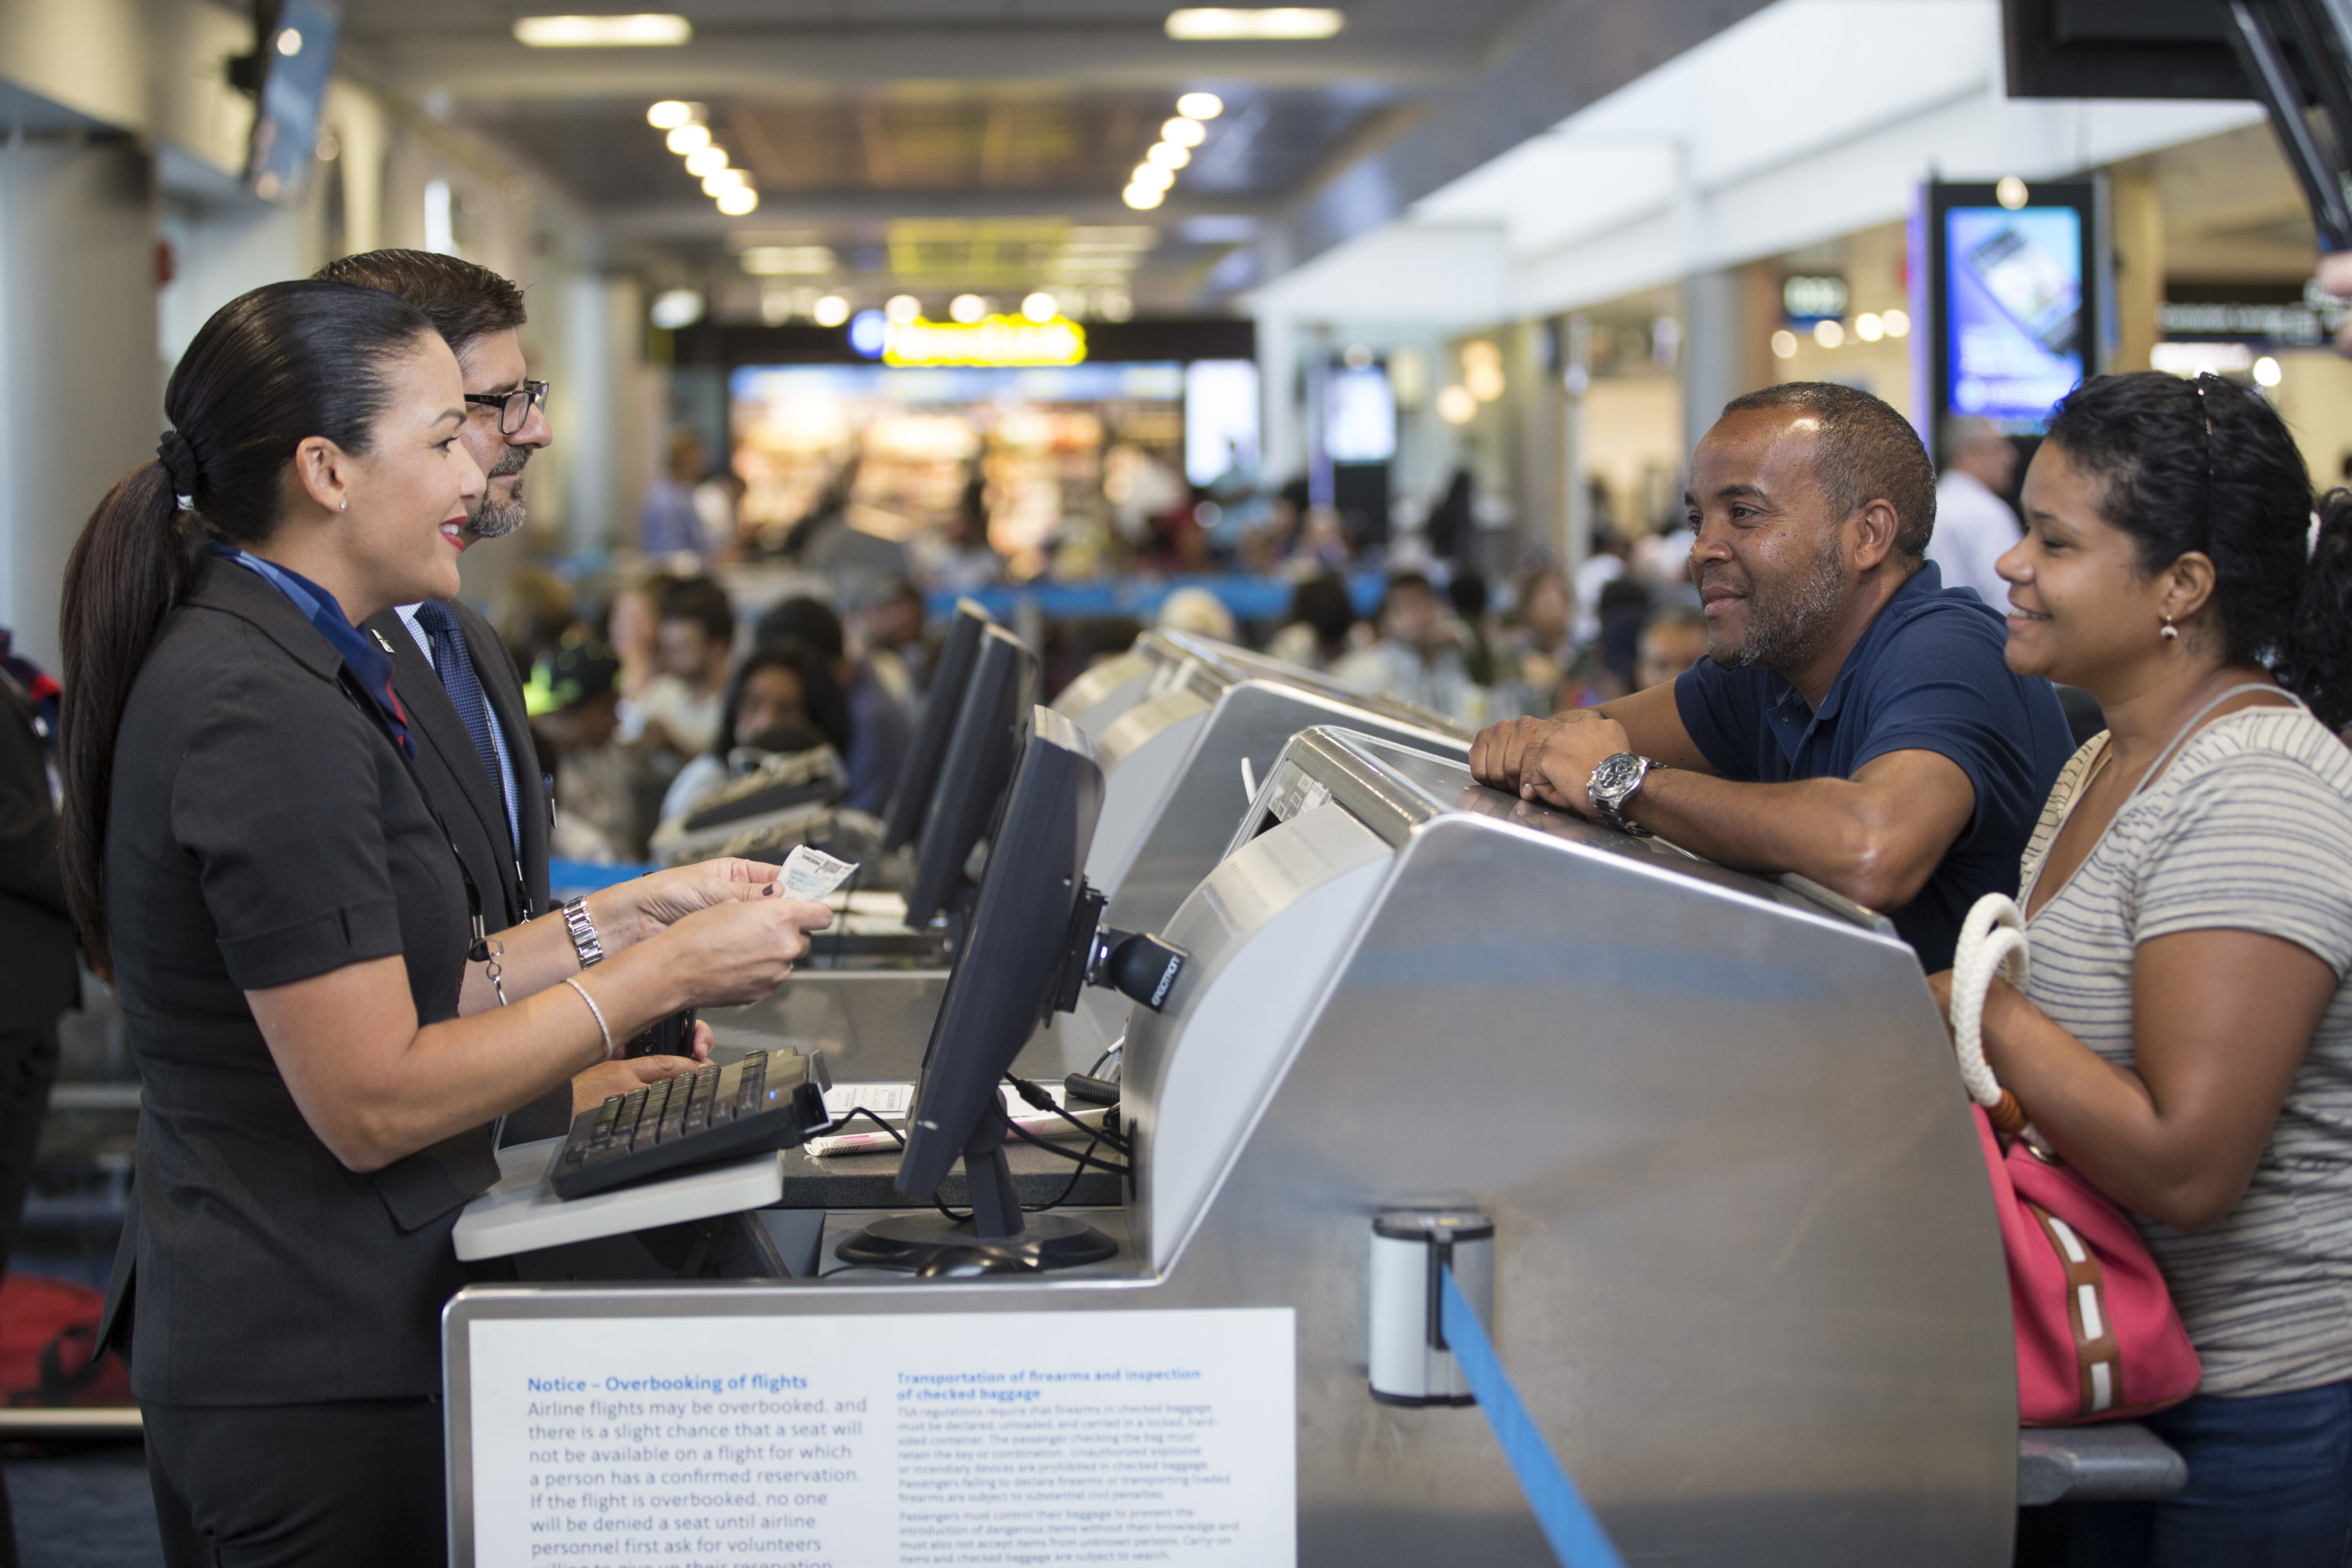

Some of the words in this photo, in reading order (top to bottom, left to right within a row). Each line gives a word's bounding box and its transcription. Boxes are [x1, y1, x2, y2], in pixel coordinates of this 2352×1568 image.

[528, 1378, 586, 1392] Notice
[605, 1377, 722, 1394] Overbooking
[728, 1375, 746, 1389] of
[751, 1374, 807, 1393] flights
[898, 1373, 1005, 1386] Transportation
[1010, 1370, 1025, 1382] of
[1029, 1370, 1090, 1381] firearms
[1094, 1370, 1121, 1381] and
[1125, 1370, 1200, 1383] inspection
[897, 1388, 913, 1400] of
[916, 1388, 975, 1399] checked
[980, 1388, 1041, 1402] baggage
[528, 1402, 585, 1416] Airline
[590, 1400, 644, 1421] flights
[649, 1403, 686, 1419] may
[691, 1400, 713, 1415] be
[834, 1399, 866, 1413] and
[898, 1406, 918, 1417] TSA
[920, 1407, 984, 1421] regulations
[985, 1406, 1028, 1418] require
[1029, 1405, 1053, 1415] that
[1054, 1404, 1102, 1414] firearms
[1116, 1403, 1163, 1414] checked
[1165, 1403, 1212, 1417] baggage
[528, 1425, 575, 1440] there
[582, 1425, 593, 1439] is
[599, 1428, 610, 1439] a
[615, 1424, 661, 1443] slight
[666, 1425, 729, 1438] chance
[735, 1423, 770, 1437] that
[775, 1425, 786, 1436] a
[791, 1424, 826, 1436] seat
[832, 1421, 862, 1436] will
[897, 1422, 926, 1432] must
[927, 1421, 942, 1432] be
[1058, 1419, 1079, 1429] and
[1080, 1418, 1121, 1429] carried
[897, 1436, 927, 1446] sided
[989, 1433, 1010, 1444] The
[1011, 1435, 1069, 1447] passenger
[1070, 1433, 1120, 1446] checking
[1121, 1432, 1141, 1443] the
[1143, 1432, 1164, 1445] bag
[1166, 1432, 1195, 1442] must
[529, 1450, 558, 1463] not
[564, 1449, 586, 1463] be
[591, 1447, 670, 1462] available
[674, 1449, 697, 1461] on
[702, 1450, 713, 1461] a
[718, 1445, 763, 1465] flight
[769, 1444, 794, 1460] for
[799, 1445, 851, 1459] which
[897, 1450, 931, 1460] retain
[933, 1450, 953, 1460] the
[955, 1450, 975, 1461] key
[975, 1450, 989, 1460] or
[1071, 1446, 1148, 1457] Unauthorized
[1149, 1446, 1202, 1459] explosive
[897, 1466, 910, 1475] or
[913, 1464, 971, 1476] incendiary
[973, 1463, 1015, 1474] devices
[1017, 1464, 1036, 1473] are
[1038, 1461, 1097, 1475] prohibited
[1112, 1461, 1159, 1471] checked
[529, 1475, 539, 1486] a
[546, 1474, 604, 1490] person
[611, 1471, 641, 1485] has
[645, 1473, 655, 1484] a
[661, 1468, 750, 1484] confirmed
[898, 1479, 959, 1492] Passengers
[962, 1477, 996, 1490] failing
[998, 1478, 1011, 1488] to
[1013, 1477, 1054, 1487] declare
[1057, 1475, 1104, 1486] firearms
[1105, 1476, 1118, 1486] or
[1120, 1475, 1189, 1488] transporting
[1192, 1474, 1231, 1484] loaded
[531, 1494, 543, 1508] If
[547, 1495, 576, 1509] the
[582, 1493, 627, 1513] flight
[633, 1494, 645, 1508] is
[766, 1494, 789, 1506] no
[794, 1494, 827, 1505] one
[898, 1493, 945, 1503] firearms
[946, 1494, 966, 1502] are
[968, 1492, 1008, 1504] subject
[1010, 1491, 1022, 1502] to
[1025, 1491, 1085, 1501] substantial
[1087, 1488, 1110, 1501] civil
[530, 1518, 561, 1532] will
[567, 1518, 587, 1532] be
[593, 1516, 653, 1531] denied
[659, 1519, 668, 1530] a
[674, 1518, 710, 1530] seat
[715, 1515, 754, 1530] until
[760, 1515, 815, 1529] airline
[899, 1512, 960, 1524] Passengers
[962, 1511, 991, 1521] must
[993, 1509, 1033, 1521] control
[1036, 1509, 1063, 1519] their
[1065, 1510, 1112, 1523] baggage
[1114, 1508, 1127, 1519] to
[1129, 1508, 1173, 1520] prevent
[1175, 1508, 1194, 1517] the
[898, 1526, 968, 1536] introduction
[971, 1523, 983, 1535] of
[985, 1525, 1044, 1538] dangerous
[1046, 1524, 1079, 1534] items
[1080, 1523, 1123, 1533] without
[1125, 1522, 1152, 1532] their
[1155, 1522, 1216, 1535] knowledge
[1218, 1521, 1240, 1531] and
[532, 1541, 619, 1559] personnel
[624, 1538, 659, 1553] first
[664, 1539, 692, 1553] ask
[696, 1537, 721, 1552] for
[728, 1538, 822, 1552] volunteers
[899, 1541, 927, 1550] must
[930, 1541, 953, 1550] also
[955, 1540, 975, 1549] not
[977, 1539, 1014, 1551] accept
[1016, 1539, 1047, 1548] items
[1049, 1537, 1077, 1548] from
[1079, 1537, 1131, 1547] unknown
[1183, 1535, 1232, 1548] Carry-on
[899, 1555, 930, 1564] items
[932, 1553, 954, 1564] and
[956, 1553, 1003, 1563] checked
[1005, 1553, 1051, 1566] baggage
[1054, 1553, 1073, 1562] are
[1075, 1552, 1116, 1564] subject
[1116, 1551, 1131, 1561] to
